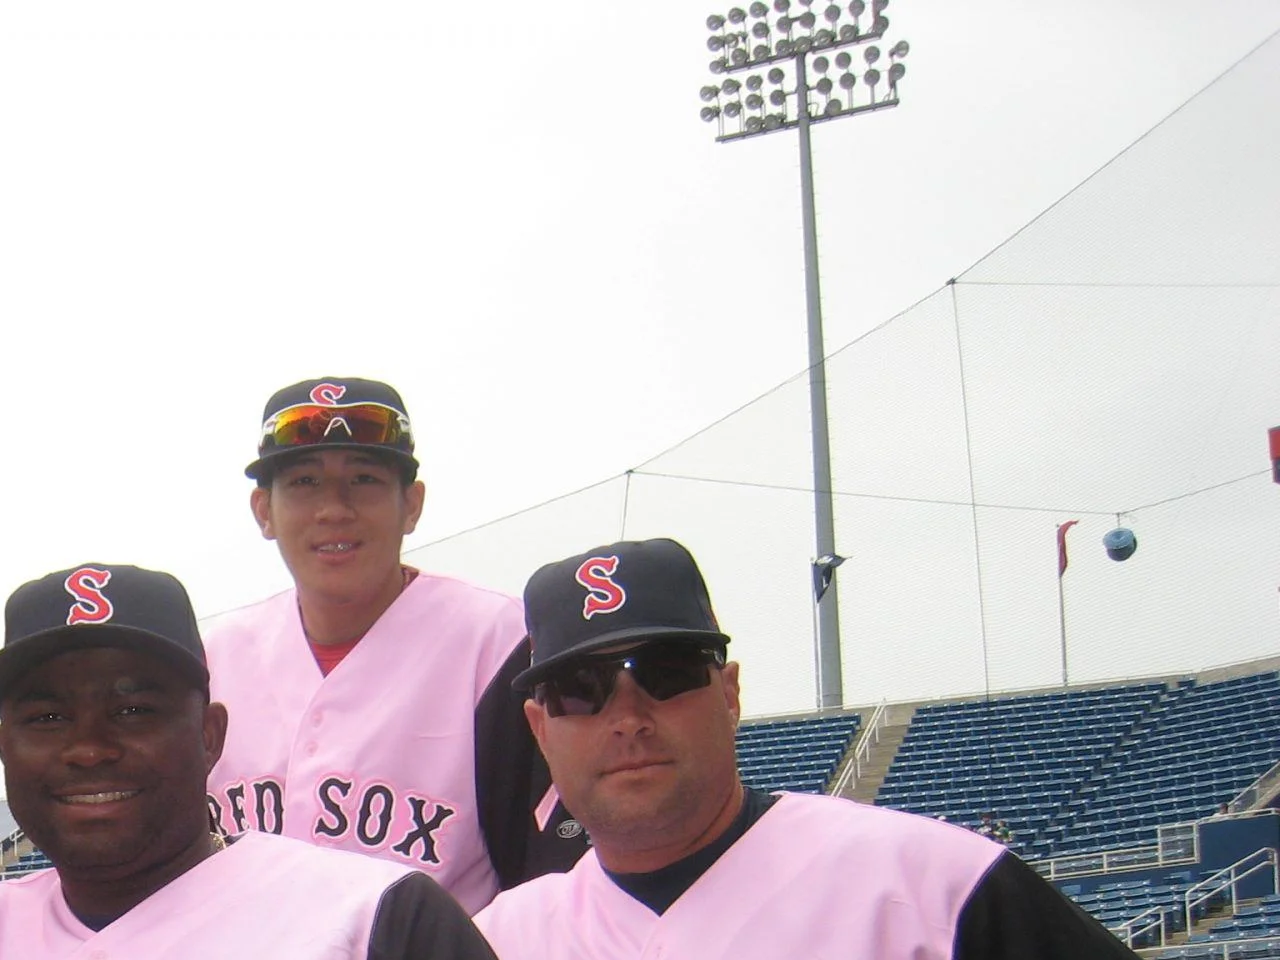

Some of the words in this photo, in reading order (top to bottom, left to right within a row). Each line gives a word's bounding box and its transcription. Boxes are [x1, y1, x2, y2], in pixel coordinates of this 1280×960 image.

[64, 566, 115, 626] S
[573, 555, 626, 620] S
[314, 776, 455, 866] SOX
